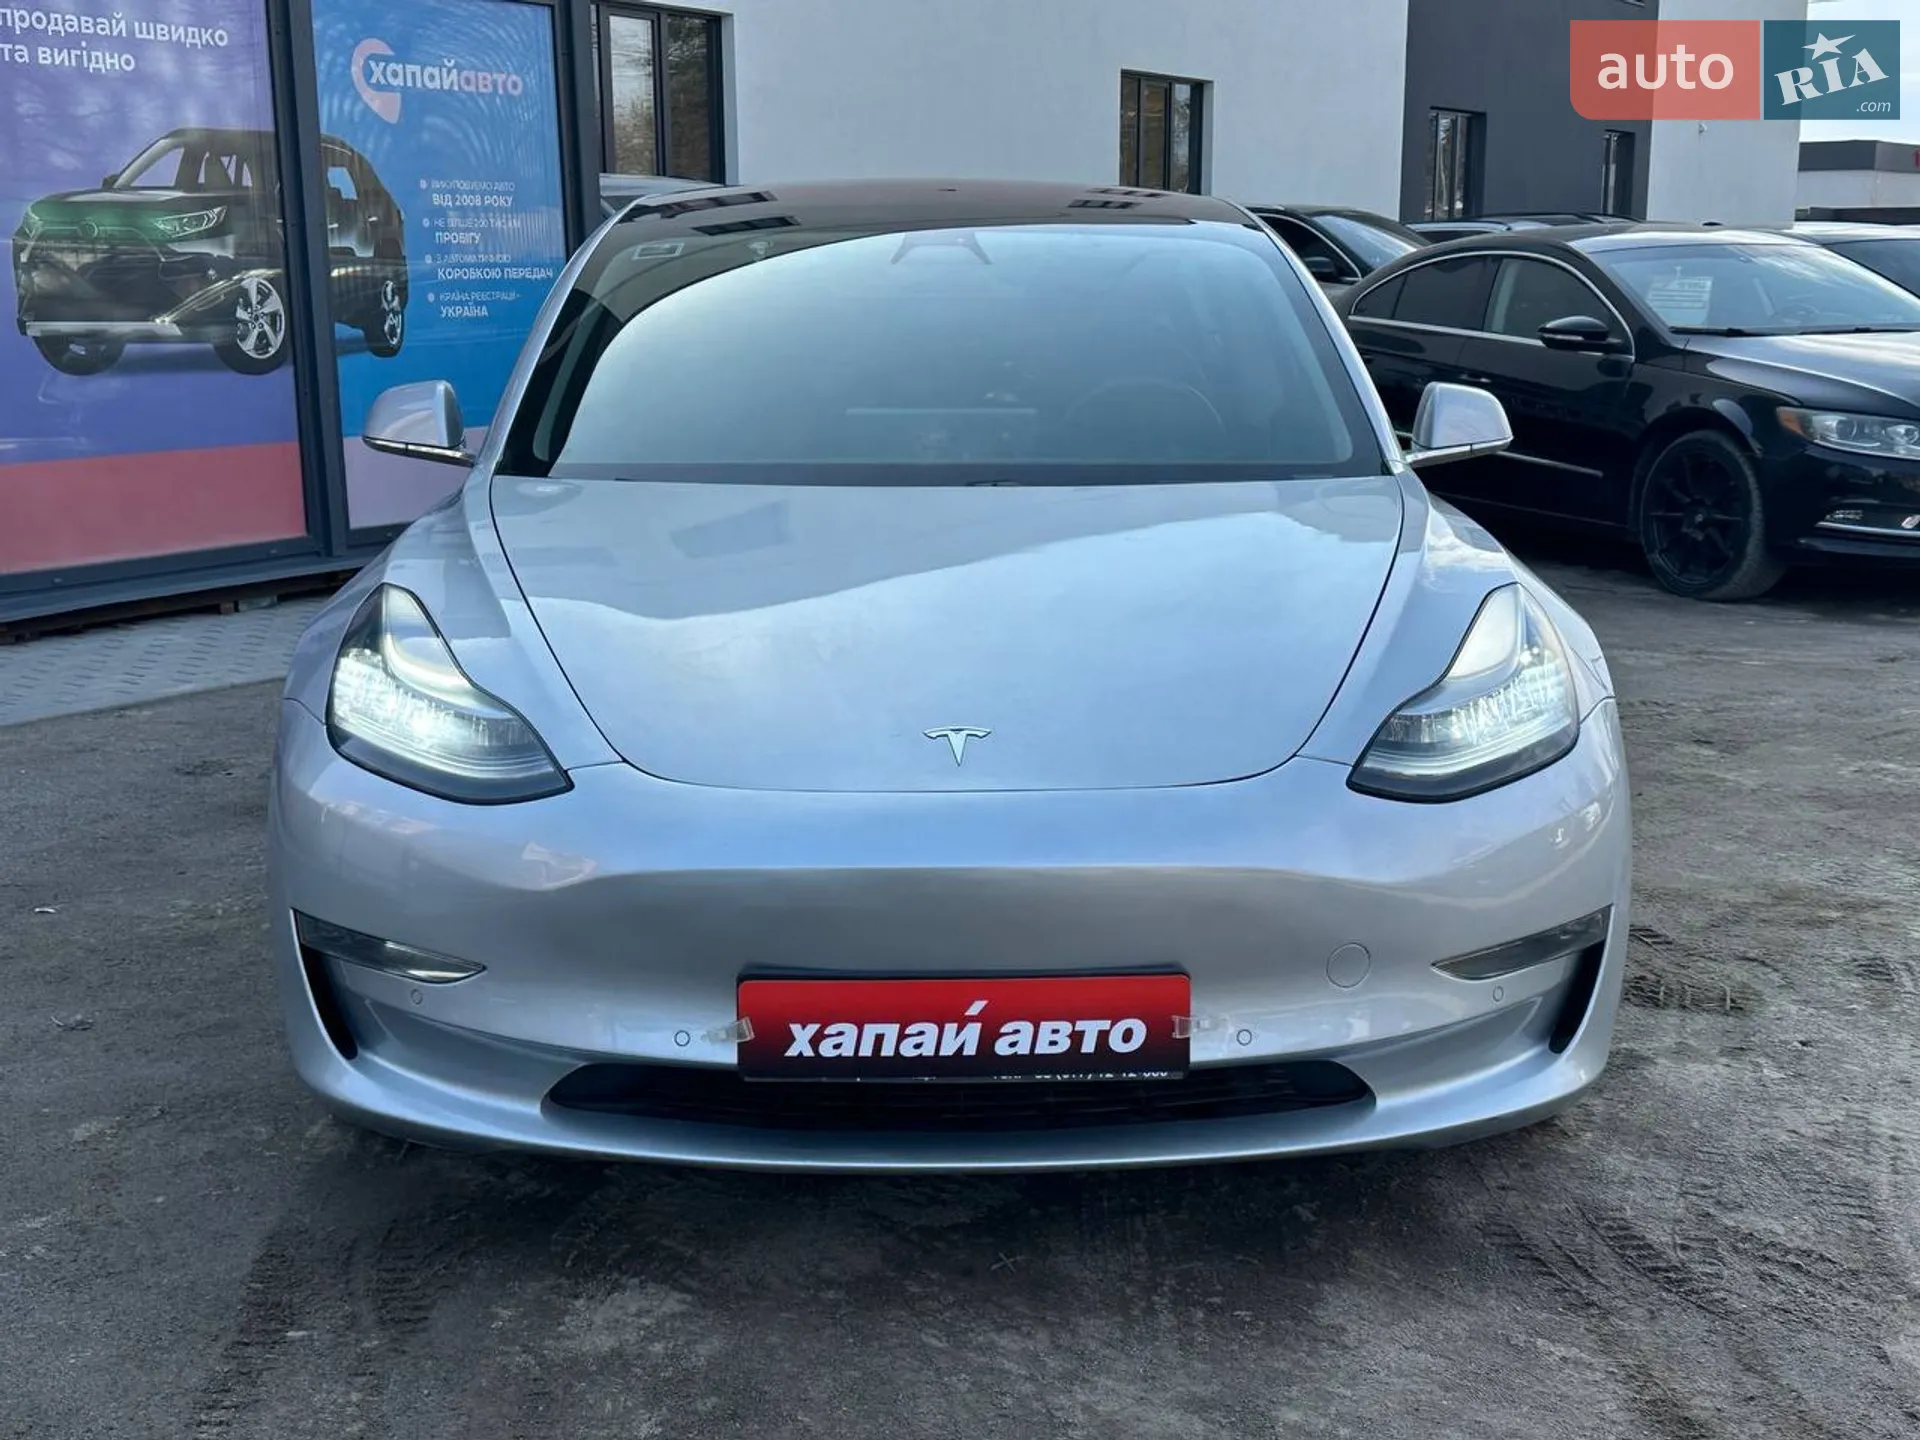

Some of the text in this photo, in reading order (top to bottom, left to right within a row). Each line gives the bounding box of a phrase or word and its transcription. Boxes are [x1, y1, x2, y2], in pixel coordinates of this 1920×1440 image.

[0, 8, 229, 49] продавай швидко
[0, 41, 135, 73] та вигідно
[432, 193, 513, 207] ВІД 2008 РОКУ
[437, 267, 554, 281] КОРОБКОЮ ПЕРЕДАЧ
[441, 301, 489, 318] УКРАЇНА
[994, 1017, 1147, 1055] авто
